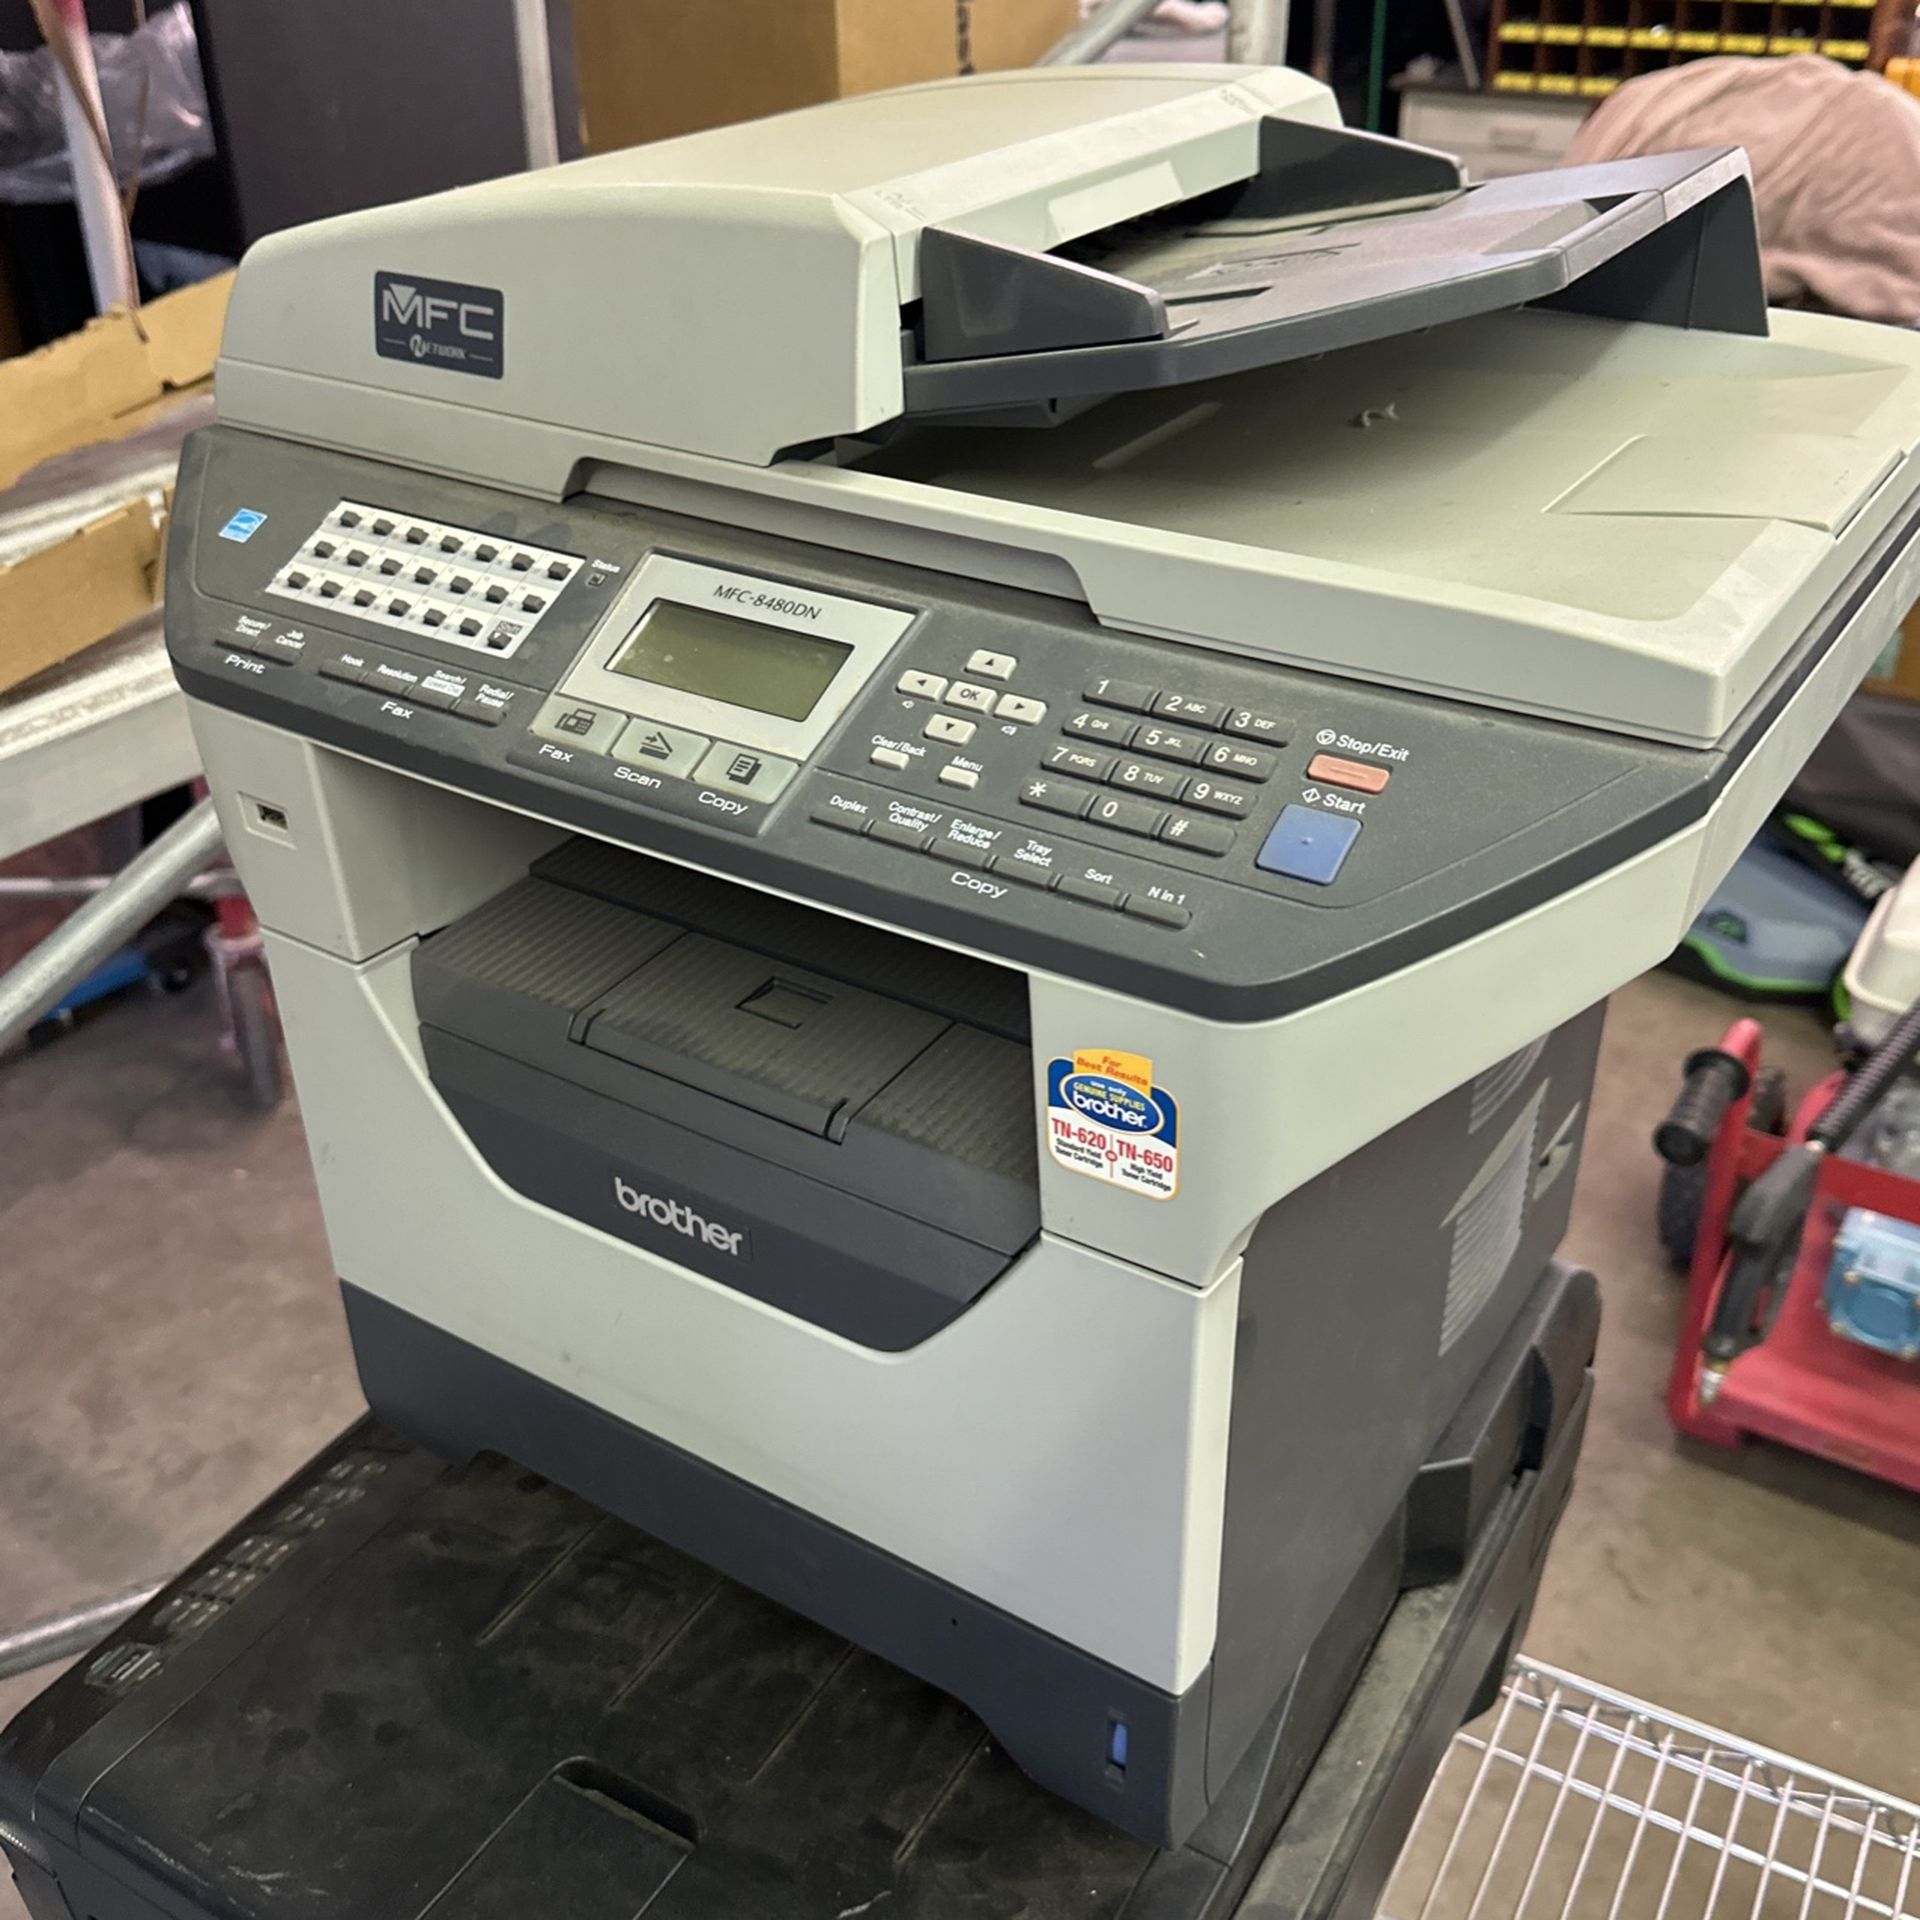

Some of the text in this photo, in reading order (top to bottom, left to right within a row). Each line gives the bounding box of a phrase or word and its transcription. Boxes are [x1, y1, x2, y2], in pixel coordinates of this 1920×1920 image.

[382, 283, 494, 341] MFC
[713, 585, 822, 619] MFC-8480DN
[225, 654, 266, 674] Print
[376, 664, 419, 683] Resolution
[960, 688, 980, 701] OK
[1097, 679, 1110, 694] 1
[380, 701, 414, 719] Fax
[1164, 696, 1207, 714] 2 ABC
[1072, 713, 1089, 728] 4
[1234, 712, 1277, 730] 3 DEF
[871, 735, 927, 757] Clear/Back
[1145, 729, 1163, 745] 5
[539, 744, 574, 763] Fax
[1051, 746, 1069, 762] 7
[1214, 746, 1258, 766] 6 MNO
[1336, 734, 1410, 761] Stop/Exit
[951, 755, 983, 772] Menu
[613, 766, 662, 789] Scan
[1123, 765, 1165, 784] 8 TUV
[698, 791, 749, 815] Copy
[1193, 783, 1244, 805] 9 WXYZ
[1323, 793, 1366, 814] Start
[829, 795, 868, 814] Duplex
[888, 801, 942, 823] Contrast/
[1102, 801, 1118, 818] 0
[888, 812, 929, 832] Quality
[950, 819, 1002, 840] Enlarge/
[947, 829, 991, 849] Reduce
[1026, 840, 1052, 856] Tray
[1014, 848, 1052, 867] Select
[951, 871, 1008, 899] Copy
[1084, 868, 1113, 885] Sort
[1147, 886, 1186, 905] N in 1
[1077, 1057, 1148, 1086] Best Results
[1102, 1056, 1122, 1068] For
[1073, 1090, 1147, 1127] brother
[1052, 1118, 1107, 1150] TN-620
[1116, 1139, 1173, 1173] TN-650
[614, 1176, 743, 1256] brother
